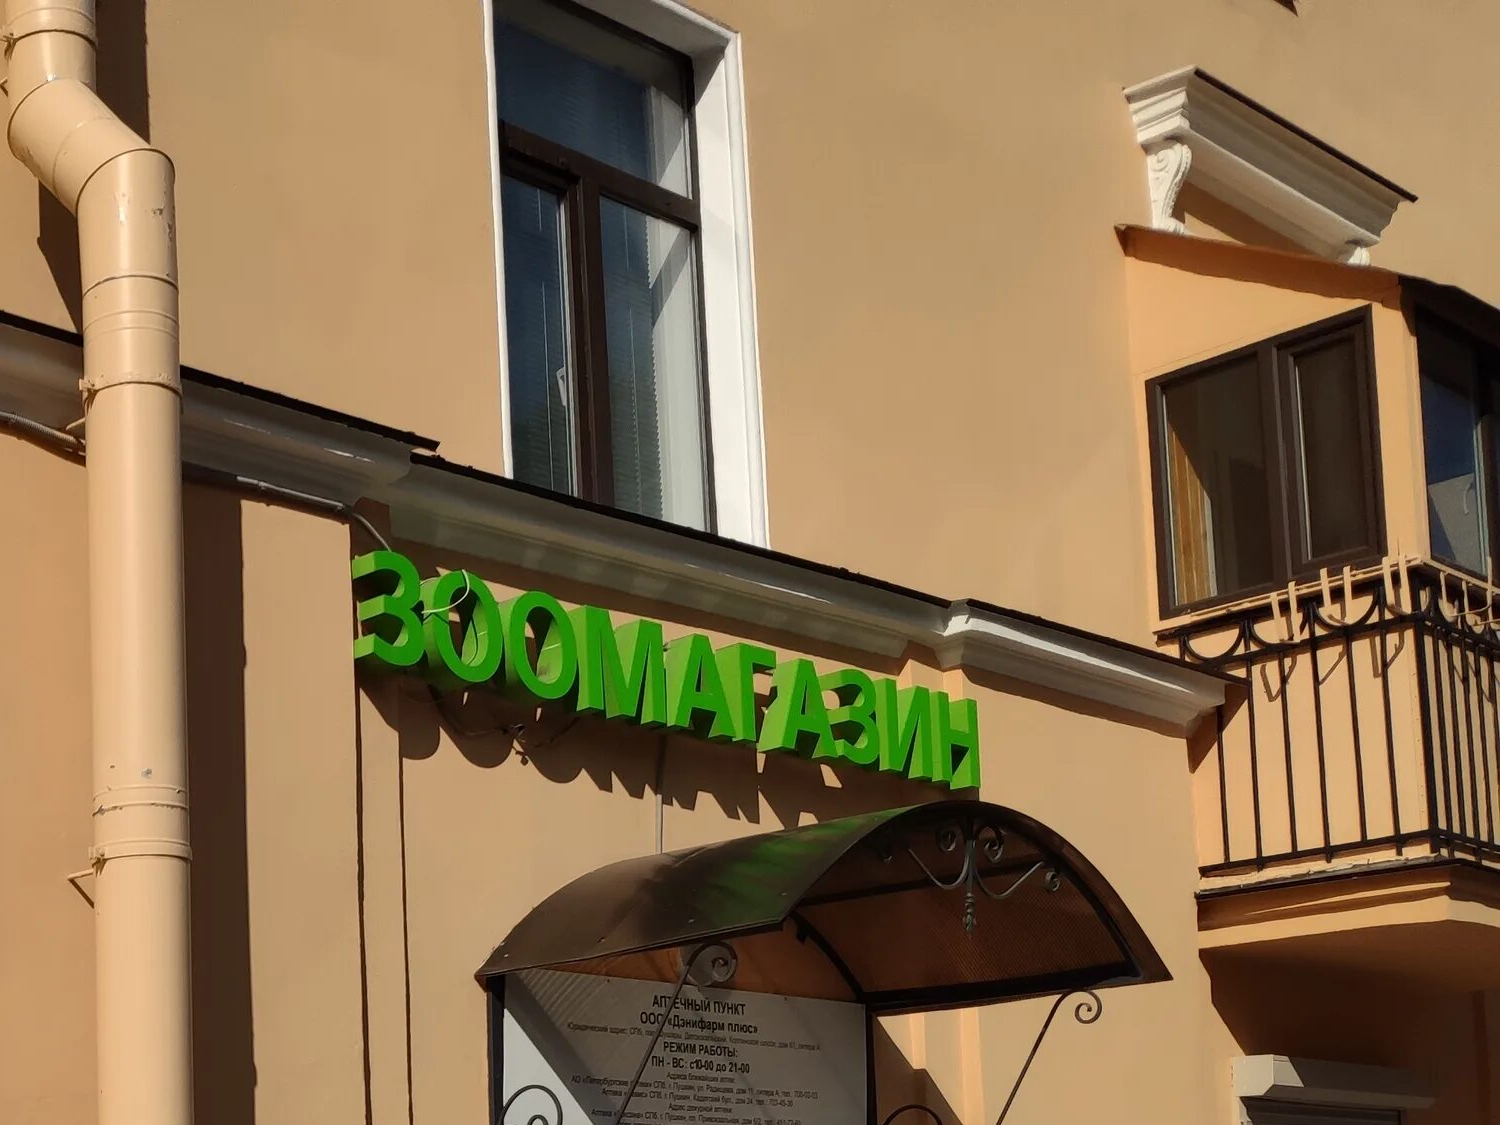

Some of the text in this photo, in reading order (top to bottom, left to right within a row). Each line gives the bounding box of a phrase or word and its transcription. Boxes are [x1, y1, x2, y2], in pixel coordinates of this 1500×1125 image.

[353, 550, 981, 790] ЗООМАГАЗИН
[652, 994, 747, 1017] АПТЕЧНЫЙ ПУНКТ
[663, 1041, 739, 1058] РЕЖИМ РАБОТЫ:
[652, 1055, 665, 1067] ПН
[716, 1063, 728, 1073] до
[728, 1060, 751, 1074] 21-00
